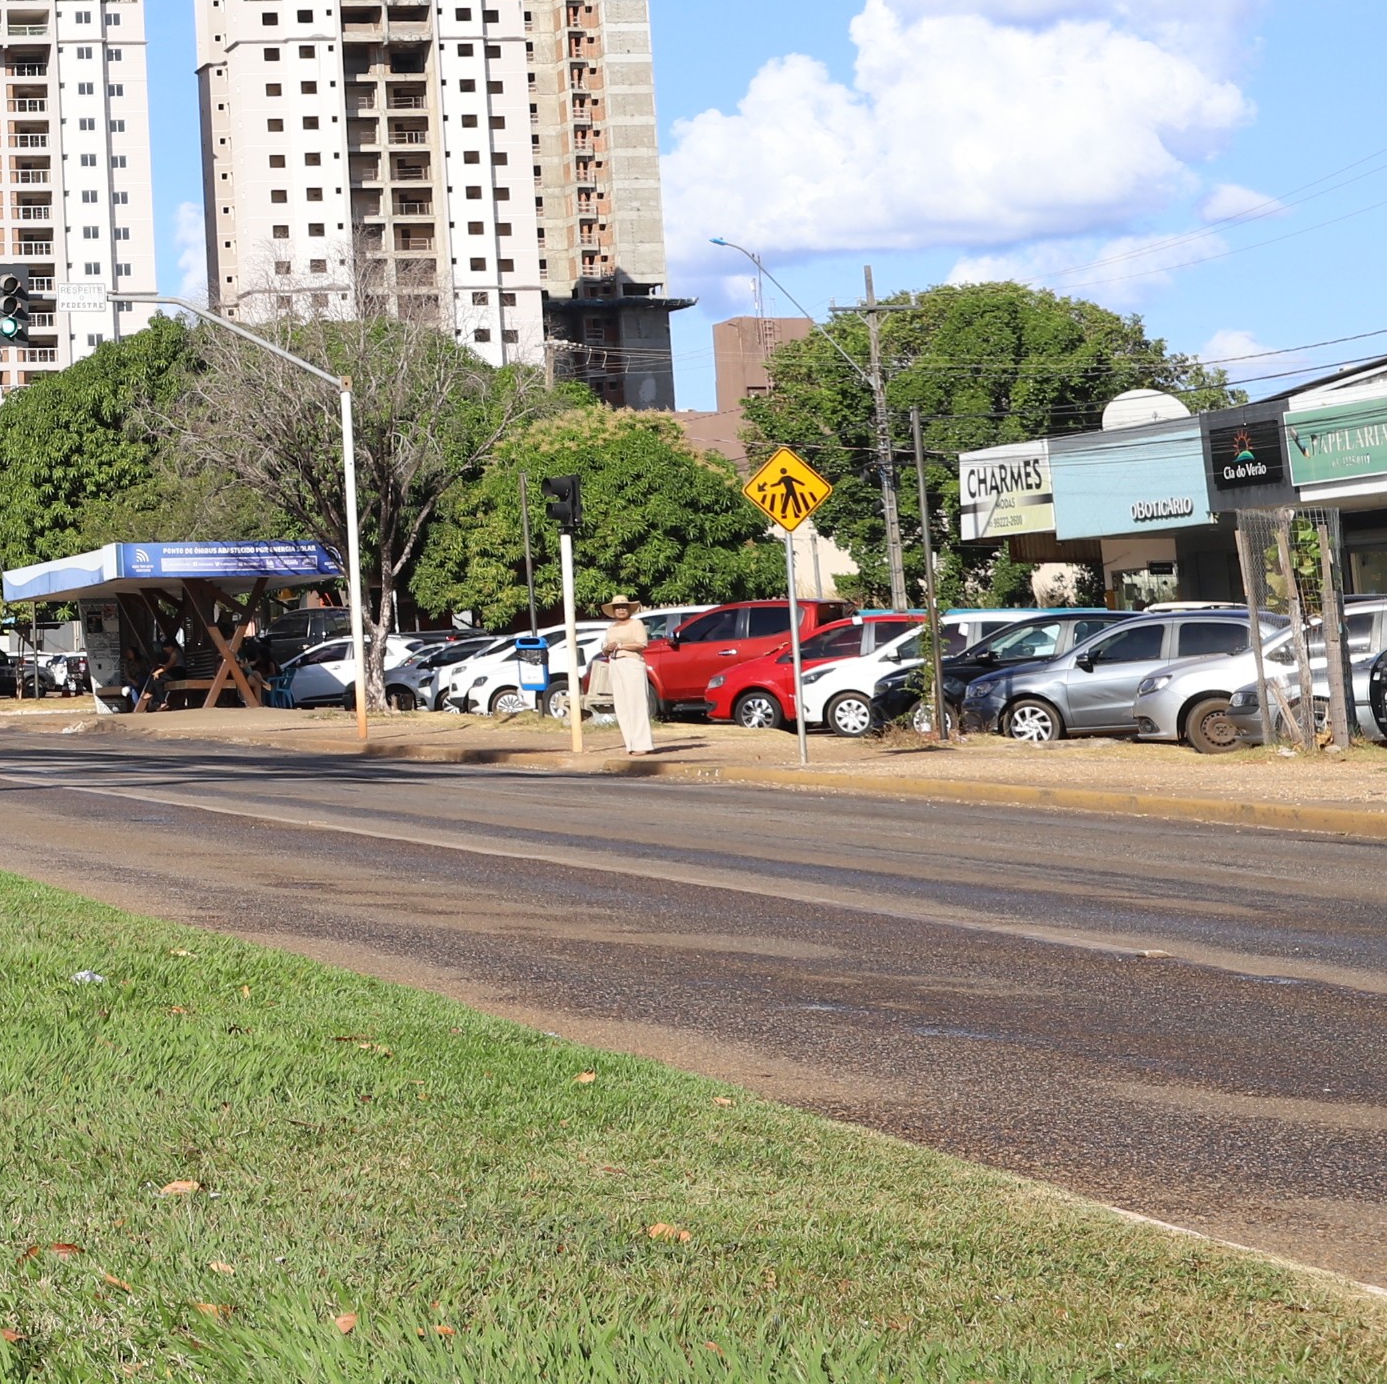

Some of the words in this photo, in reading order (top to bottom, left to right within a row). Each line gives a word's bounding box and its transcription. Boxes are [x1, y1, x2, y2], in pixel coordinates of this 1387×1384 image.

[60, 286, 103, 295] RESPEITE
[1223, 466, 1236, 480] Cia
[1236, 464, 1246, 478] do
[1245, 462, 1267, 476] Verão
[967, 459, 1042, 499] CHARMES
[163, 546, 184, 555] PONTO
[185, 546, 194, 554] DE
[194, 546, 217, 554] ÔNIBUS
